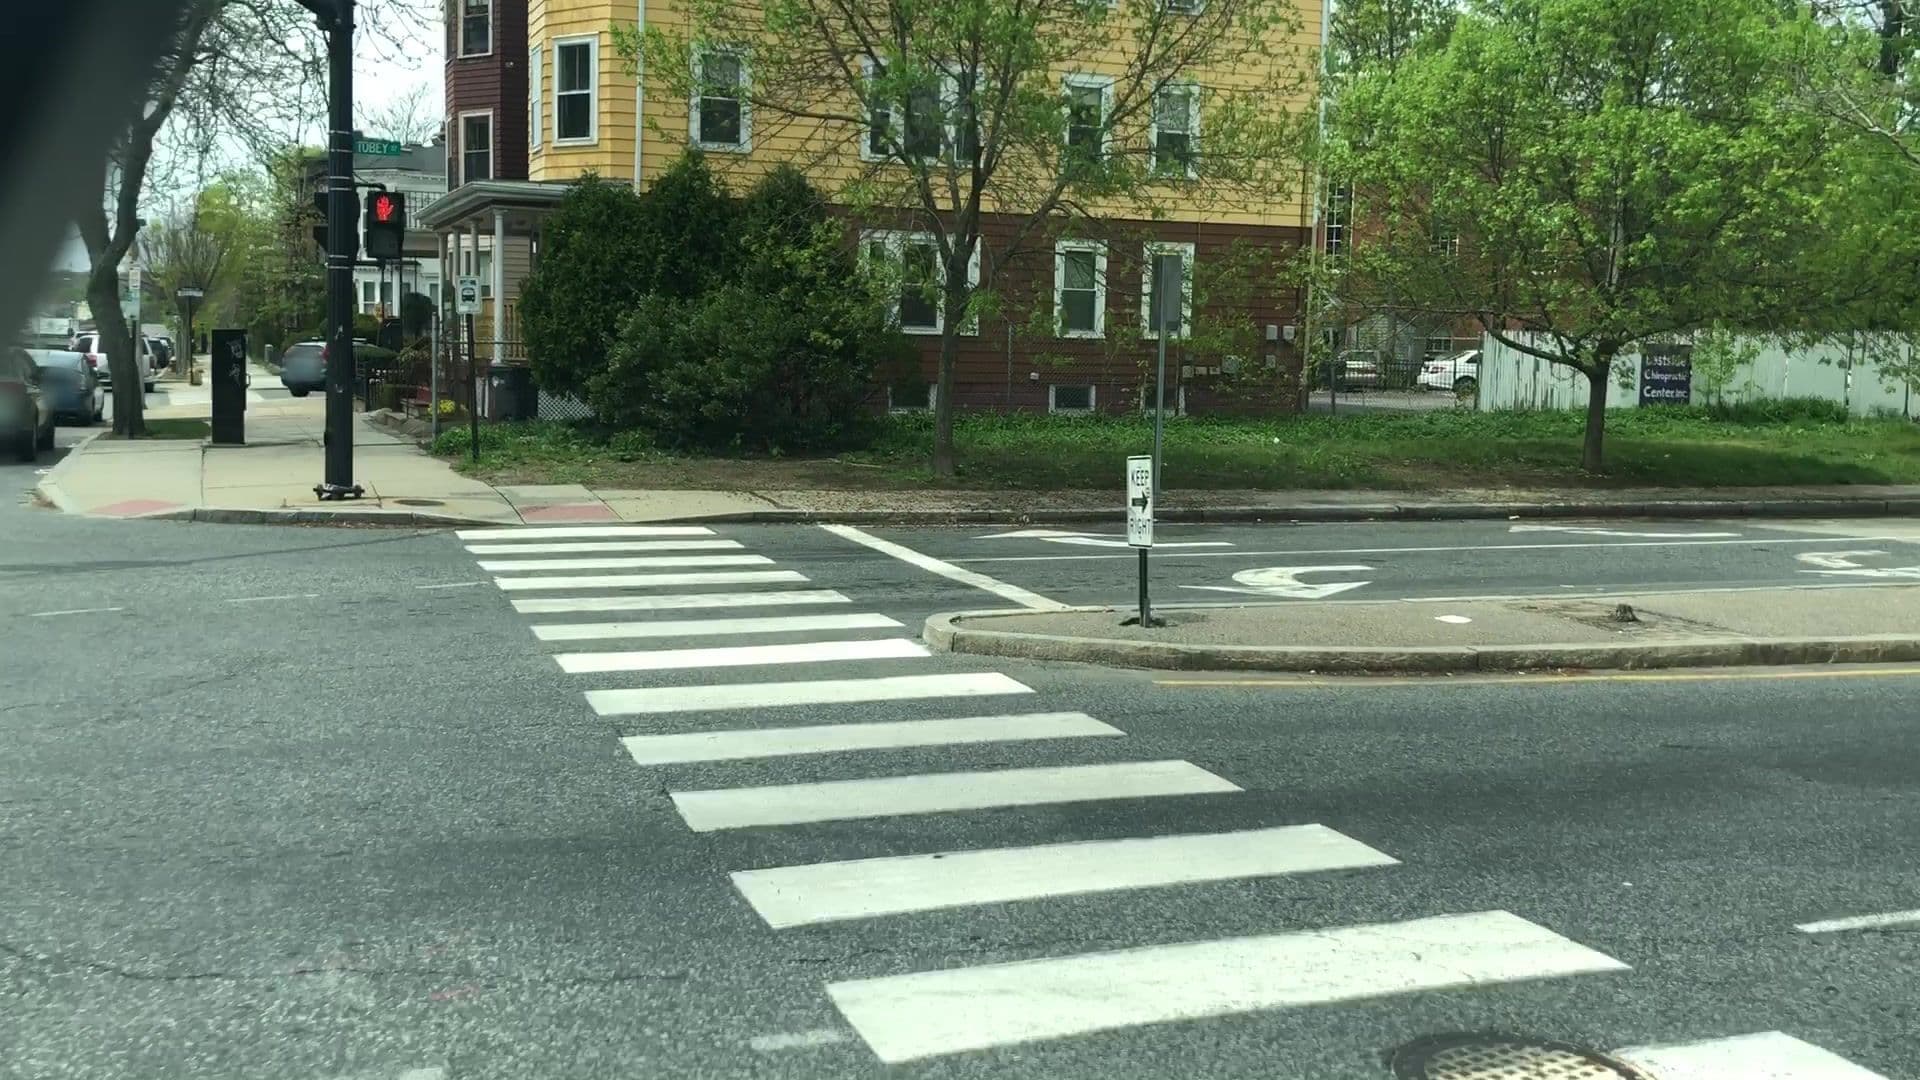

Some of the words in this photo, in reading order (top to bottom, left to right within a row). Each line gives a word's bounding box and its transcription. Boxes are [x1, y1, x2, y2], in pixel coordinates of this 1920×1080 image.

[358, 142, 389, 154] TOBEY
[1130, 470, 1149, 486] KEEP
[1129, 518, 1151, 536] RIGHT
